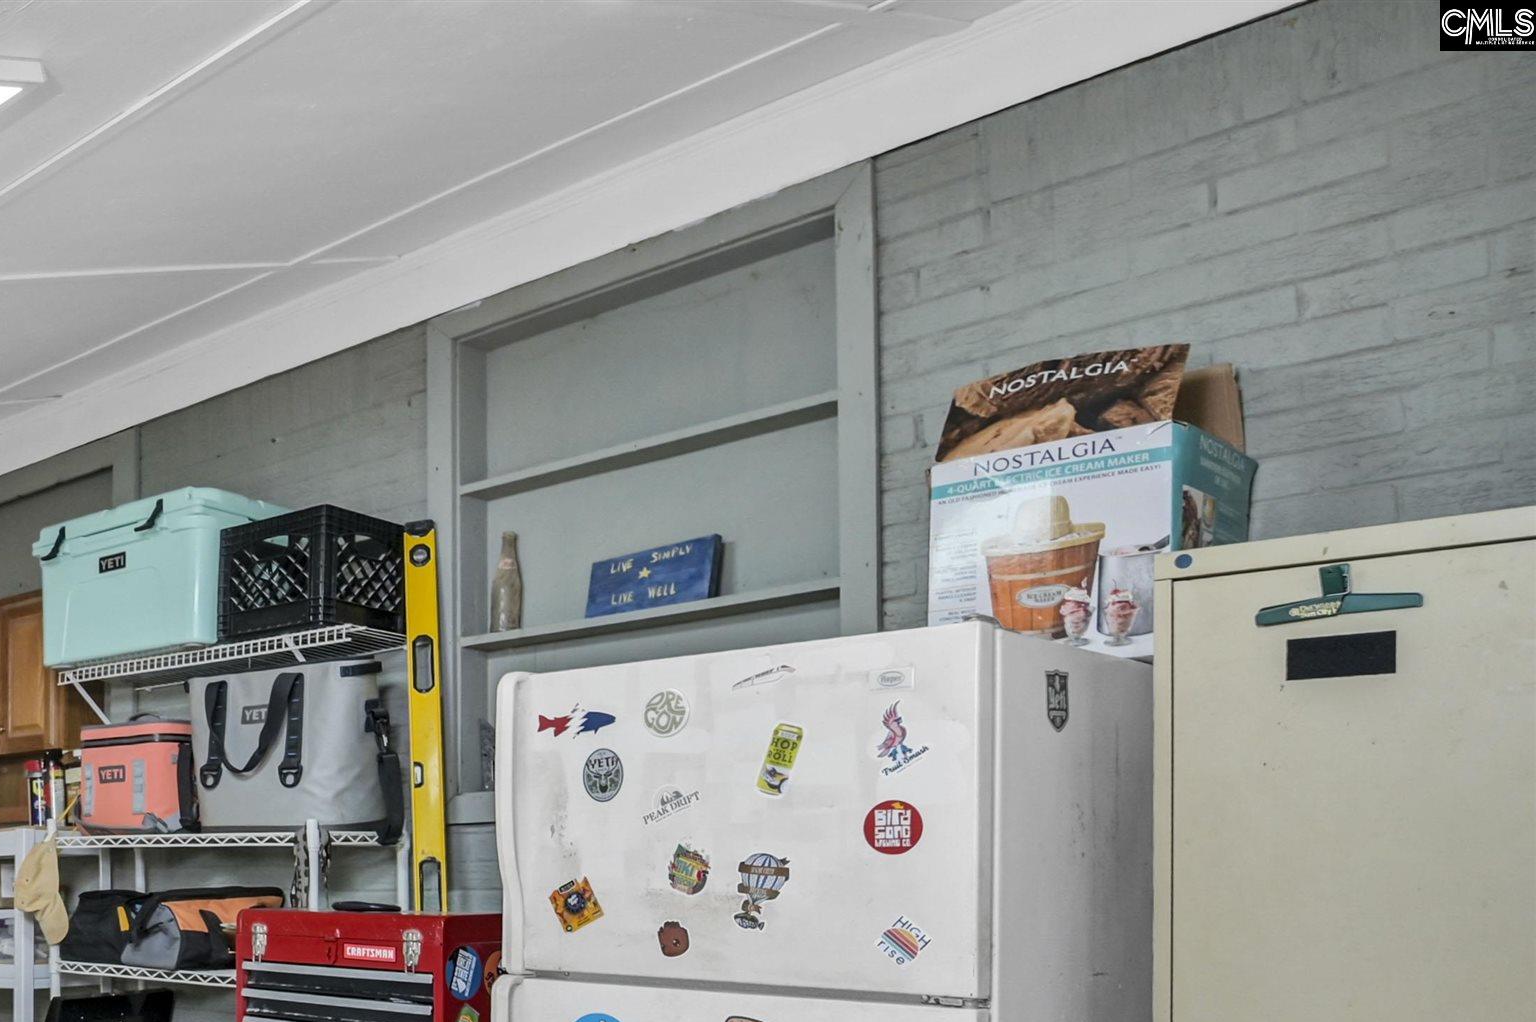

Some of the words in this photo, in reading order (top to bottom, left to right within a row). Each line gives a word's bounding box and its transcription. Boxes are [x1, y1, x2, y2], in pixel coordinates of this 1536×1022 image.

[989, 360, 1130, 399] NOSTALGIA
[973, 437, 1116, 476] NOSTALGIA
[946, 479, 993, 495] 4-QUART
[1045, 467, 1062, 480] ICE
[1065, 461, 1105, 475] CREAM
[1107, 452, 1150, 469] MAKER
[100, 554, 124, 571] YETI
[610, 558, 635, 574] LIVE
[611, 591, 634, 606] LIVE
[647, 582, 677, 599] WELL
[244, 708, 268, 721] YET
[771, 737, 798, 752] HOP
[588, 756, 616, 769] YETI
[766, 750, 793, 764] ROLL
[99, 768, 124, 781] YETI
[642, 806, 670, 825] PEAK
[669, 790, 700, 811] DRIFT
[891, 915, 932, 952] HIGH
[346, 946, 395, 960] CRAFTSMAN
[876, 940, 906, 966] rise
